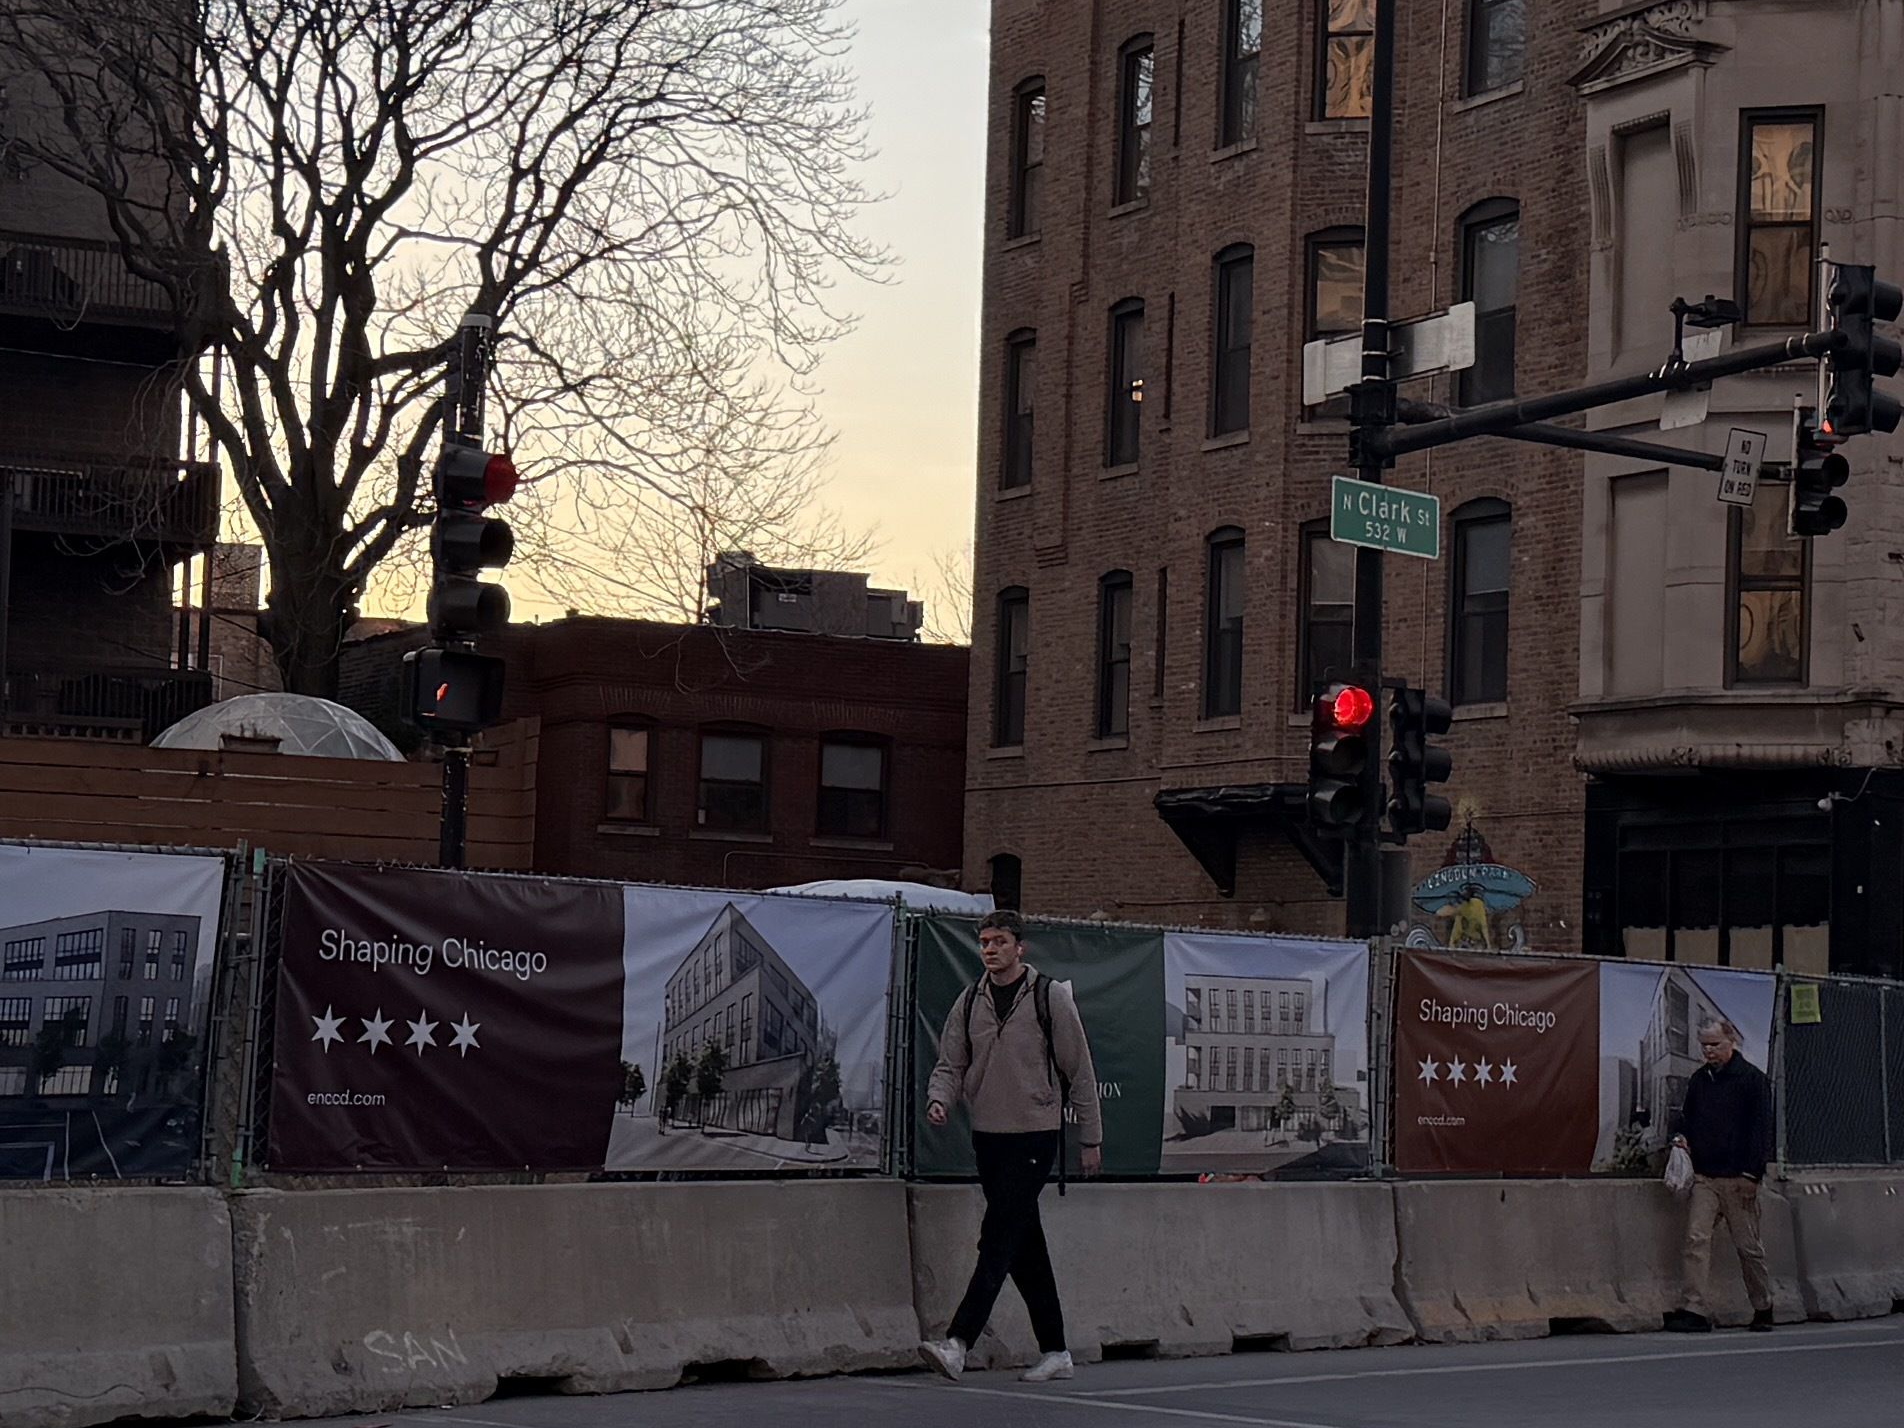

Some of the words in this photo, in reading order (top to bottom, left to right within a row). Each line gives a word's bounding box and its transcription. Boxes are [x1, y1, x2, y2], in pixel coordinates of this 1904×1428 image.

[1343, 493, 1352, 511] N
[1358, 491, 1411, 525] Clark
[1417, 509, 1430, 527] St
[1365, 521, 1391, 542] 532
[1396, 526, 1408, 545] W
[318, 928, 434, 976] Shaping
[441, 937, 548, 981] Chicago
[1418, 997, 1489, 1031] Shaping
[1492, 1001, 1557, 1034] Chicago
[306, 1088, 386, 1106] enccd.com
